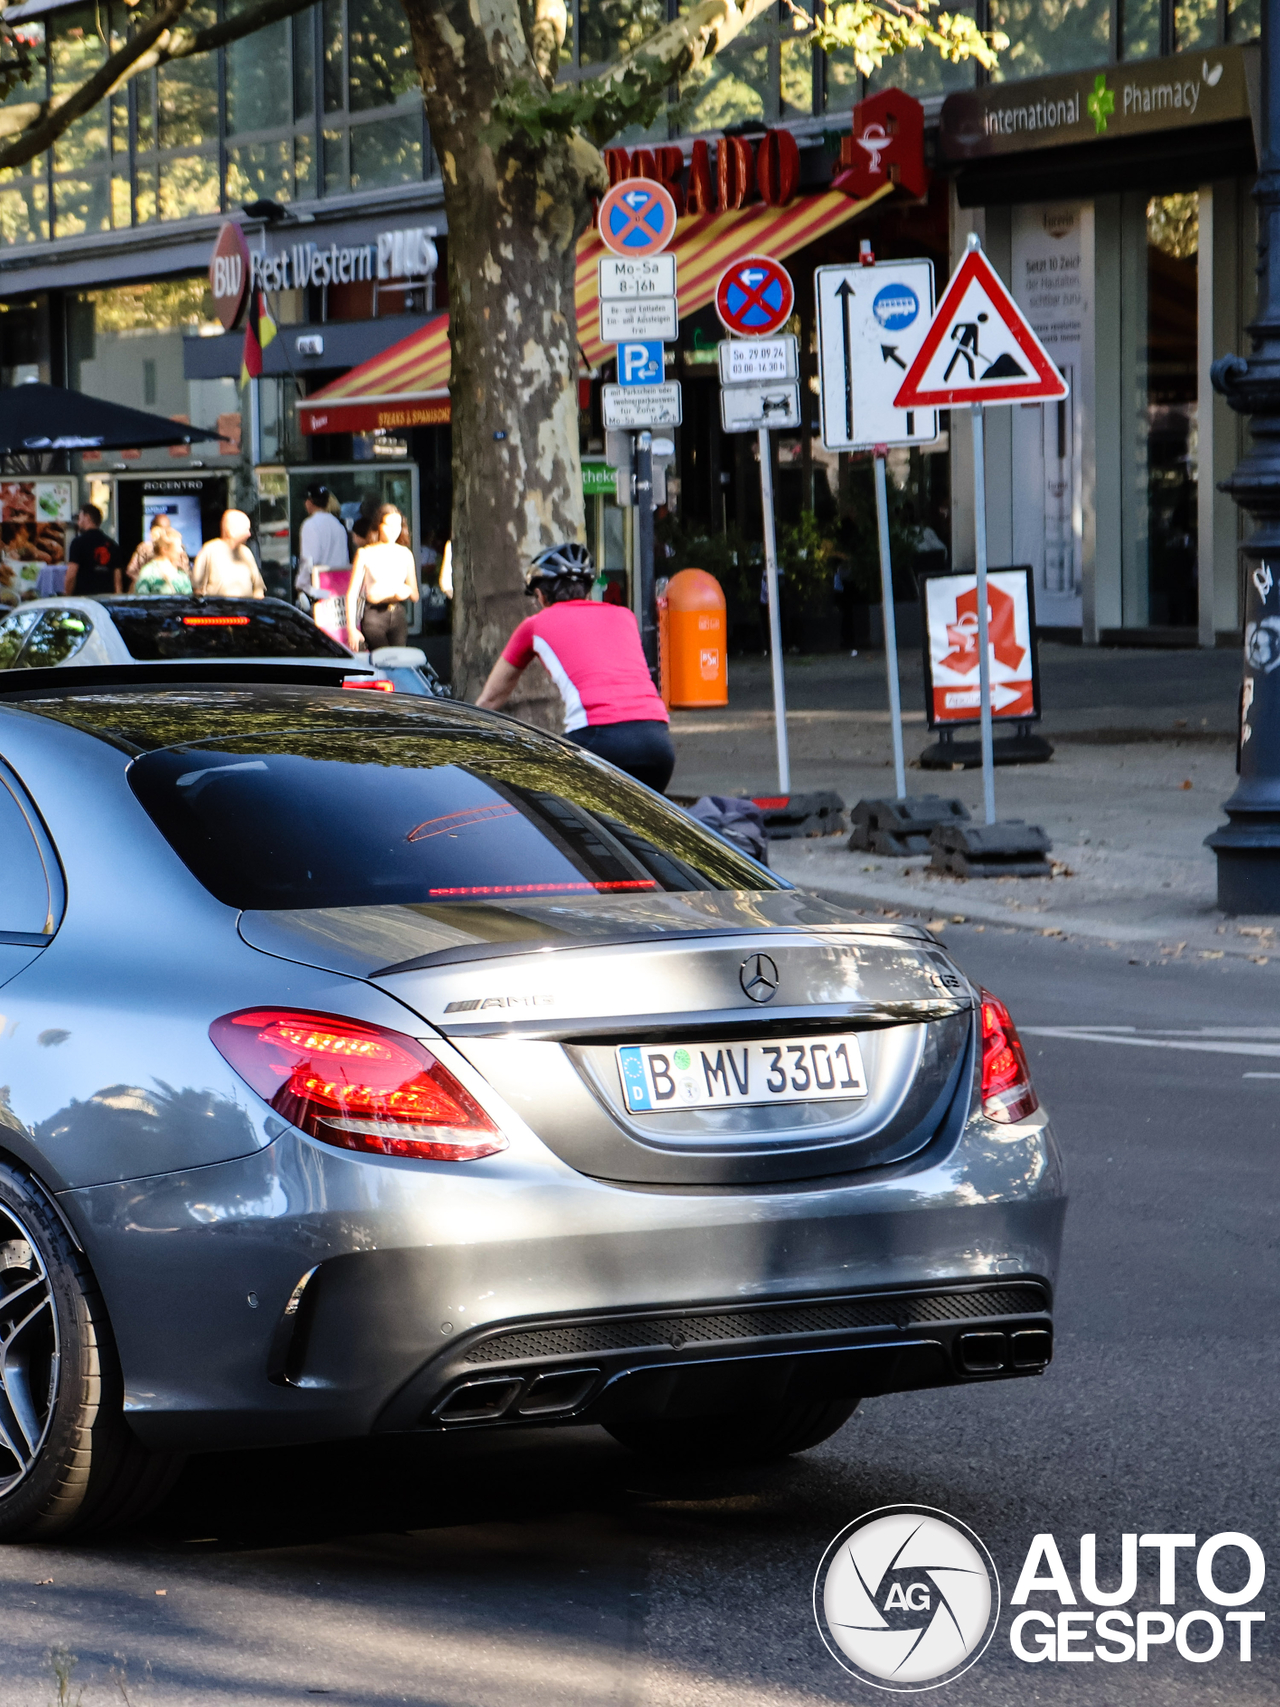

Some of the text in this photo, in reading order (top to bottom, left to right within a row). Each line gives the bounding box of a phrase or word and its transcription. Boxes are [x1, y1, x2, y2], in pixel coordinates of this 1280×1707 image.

[984, 80, 1201, 136] international Pharmacy
[250, 226, 438, 293] Best Western PLUS
[615, 261, 659, 276] Mo-Sa
[214, 254, 242, 299] BW
[620, 279, 655, 293] 8-16h
[733, 349, 747, 361] So.
[610, 385, 672, 397] mit Parkschein oder
[144, 480, 203, 490] ACCENTRO
[480, 994, 555, 1010] AMG
[647, 1043, 860, 1101] B MV 3301
